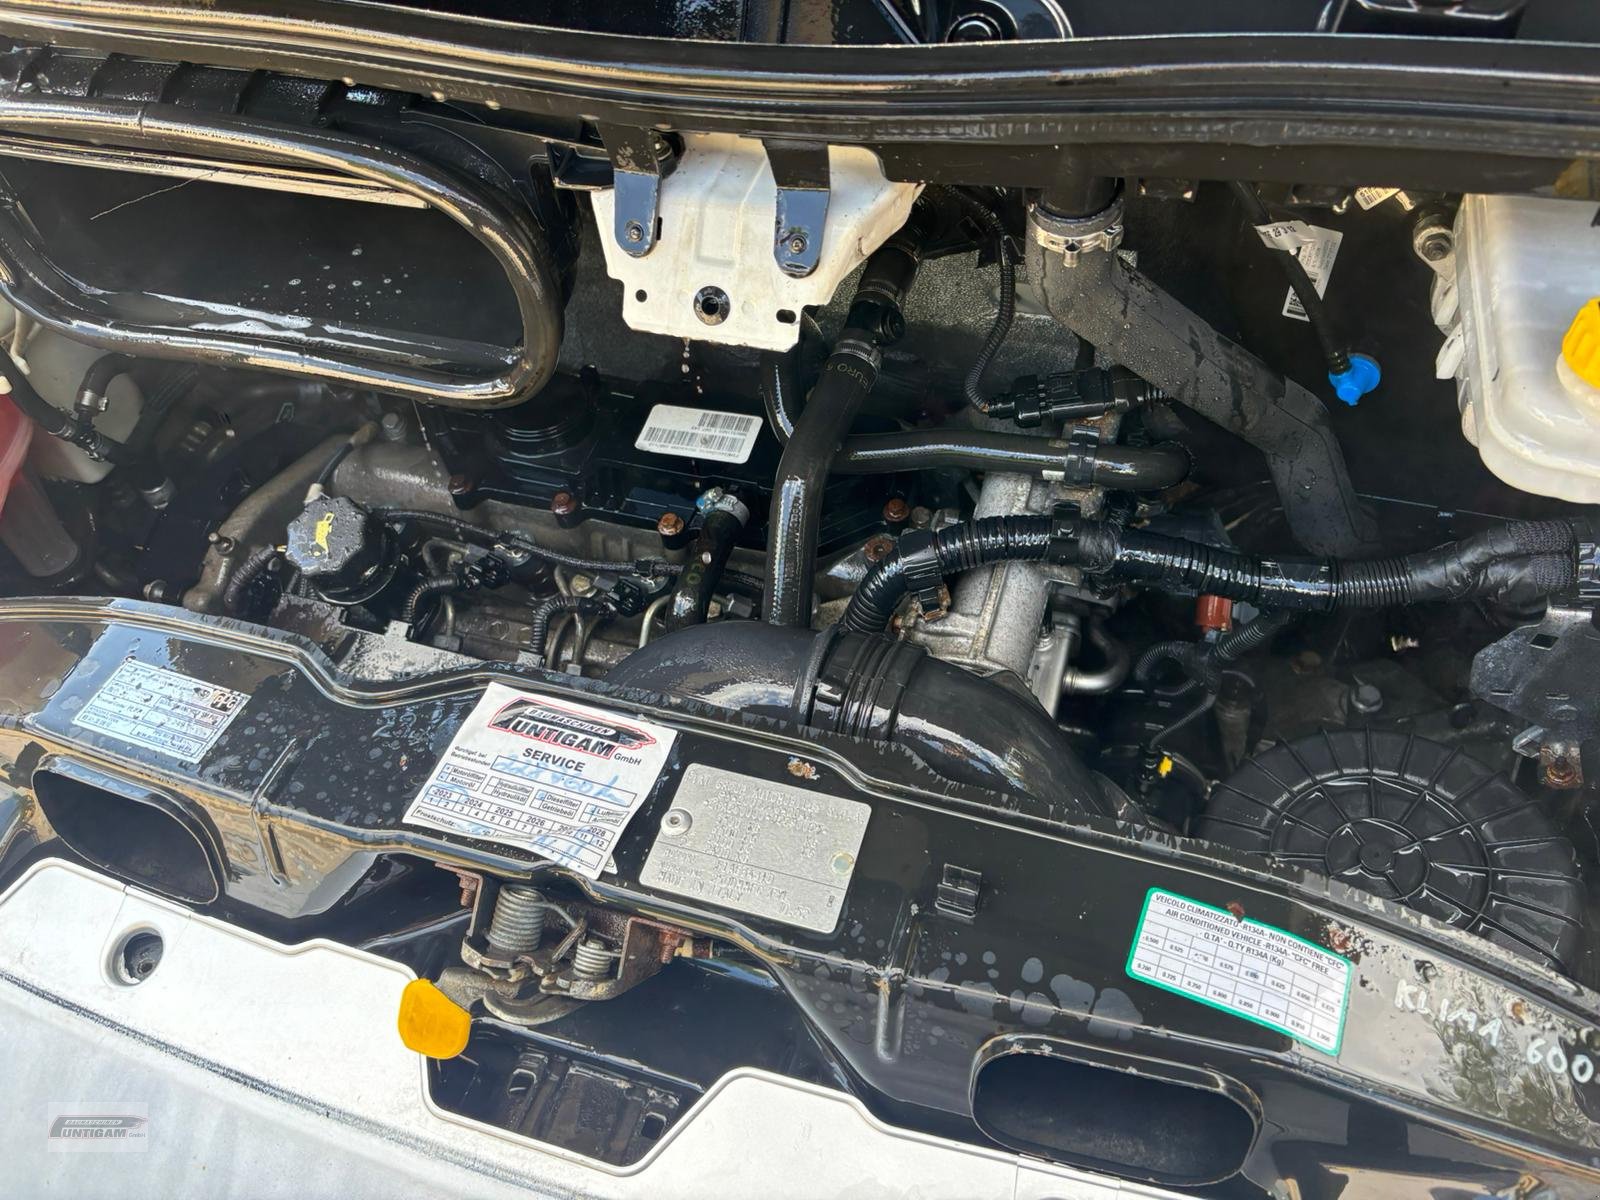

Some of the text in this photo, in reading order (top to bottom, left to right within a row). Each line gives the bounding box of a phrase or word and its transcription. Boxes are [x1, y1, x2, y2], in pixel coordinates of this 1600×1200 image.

[522, 747, 586, 772] SERVICE
[614, 752, 643, 766] GmbH
[451, 777, 476, 788] Motoröl
[541, 803, 574, 816] Getriebeöl
[546, 794, 579, 808] Dieselfilter
[434, 788, 452, 798] 2023
[465, 798, 483, 807] 2024
[495, 807, 514, 817] 2025
[526, 816, 545, 826] 2026
[587, 826, 606, 837] 2028
[596, 839, 604, 847] 12
[1155, 893, 1186, 909] VEICOLO
[1186, 905, 1239, 928] CLIMATIZZATO
[1268, 933, 1287, 945] NON
[1288, 940, 1323, 960] CONTIENE
[1325, 955, 1344, 970] "CFC"
[1166, 908, 1180, 917] AIR
[1180, 913, 1231, 936] CONDITIONED
[1231, 930, 1261, 947] VEHICLE
[1291, 951, 1312, 965] "CFC"
[1312, 961, 1329, 975] FREE
[1246, 946, 1268, 960] R134A
[1269, 954, 1285, 967] (Kg)
[1395, 979, 1594, 1084] KLIMA 600
